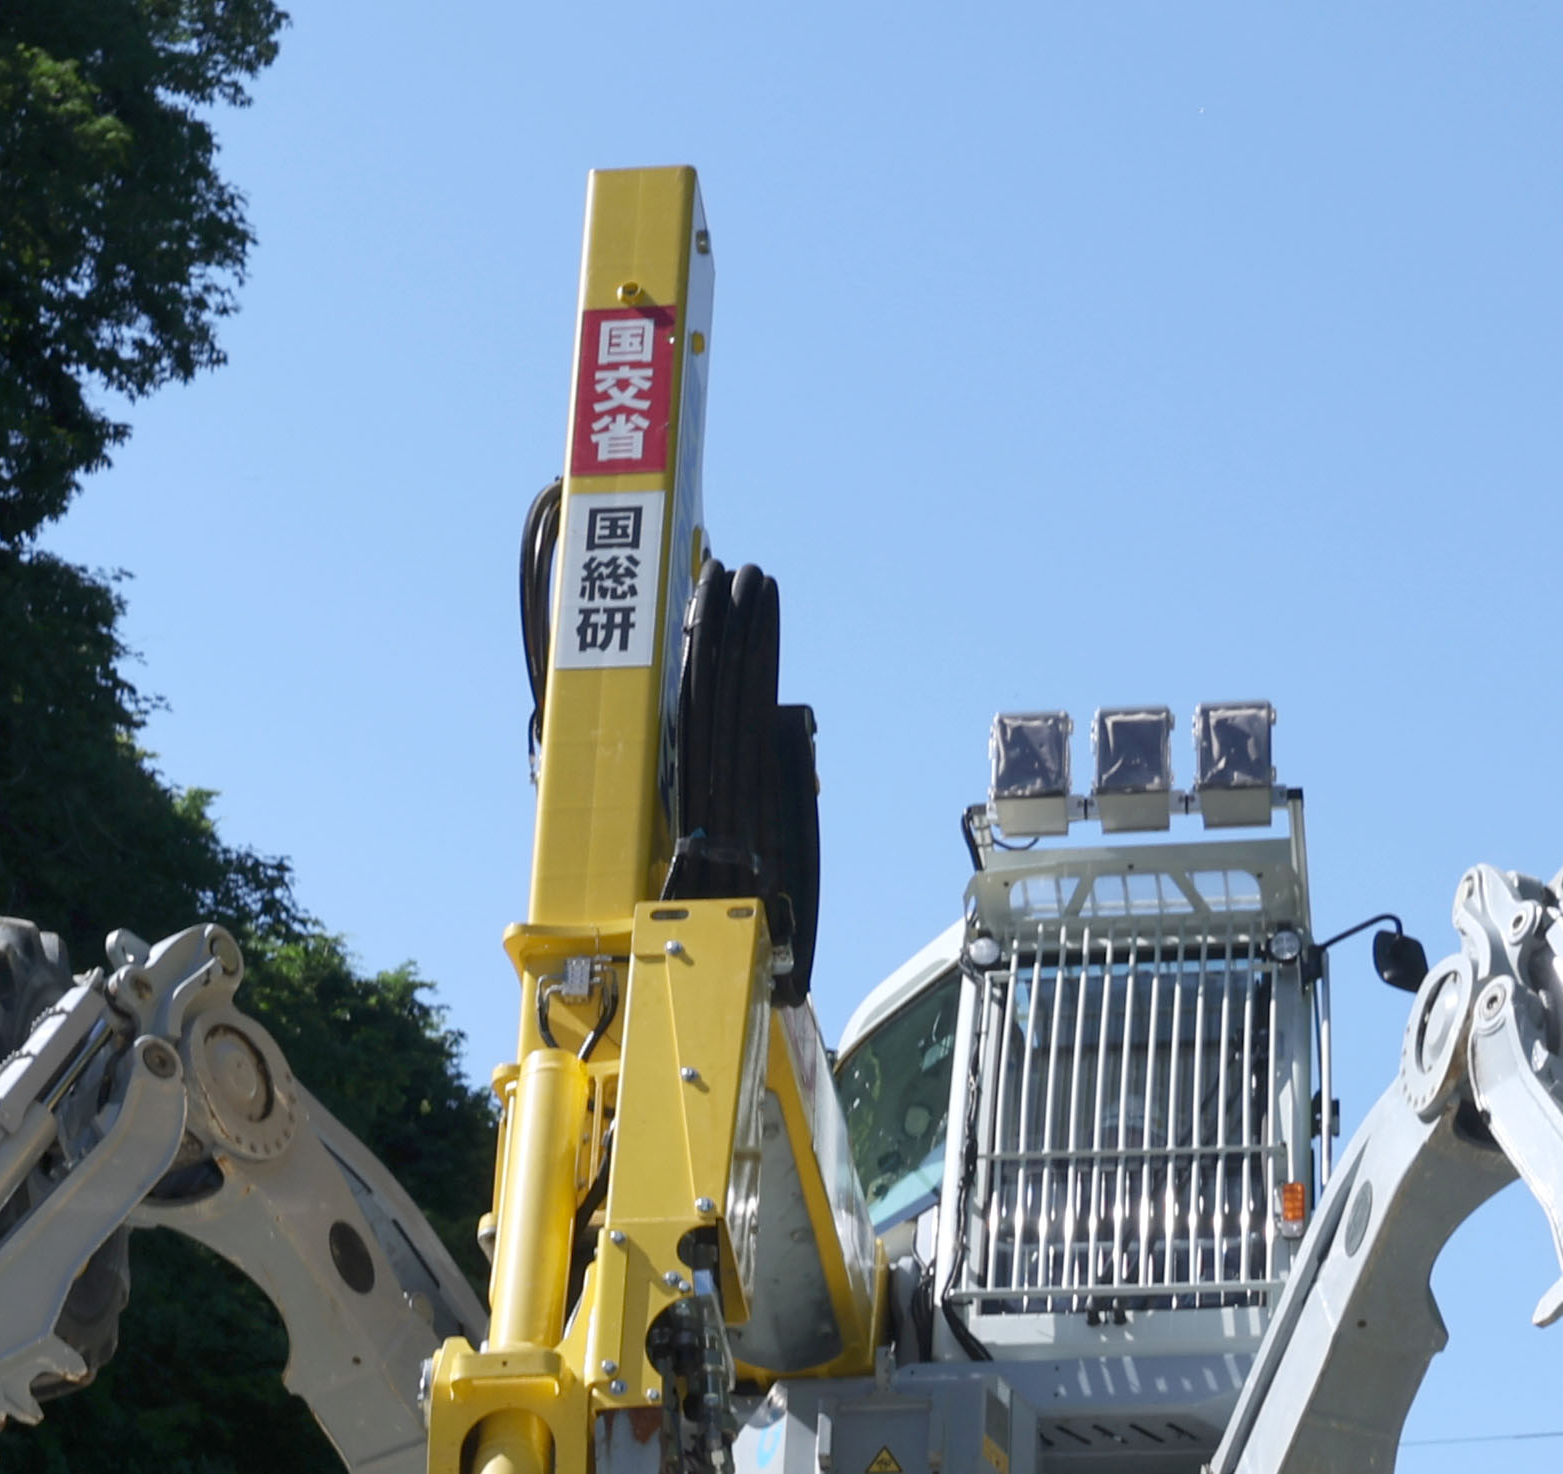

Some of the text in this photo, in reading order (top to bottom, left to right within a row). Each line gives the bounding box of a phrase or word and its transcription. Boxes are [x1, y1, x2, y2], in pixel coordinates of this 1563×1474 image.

[591, 318, 655, 462] 国交省
[576, 505, 643, 652] 国総研
